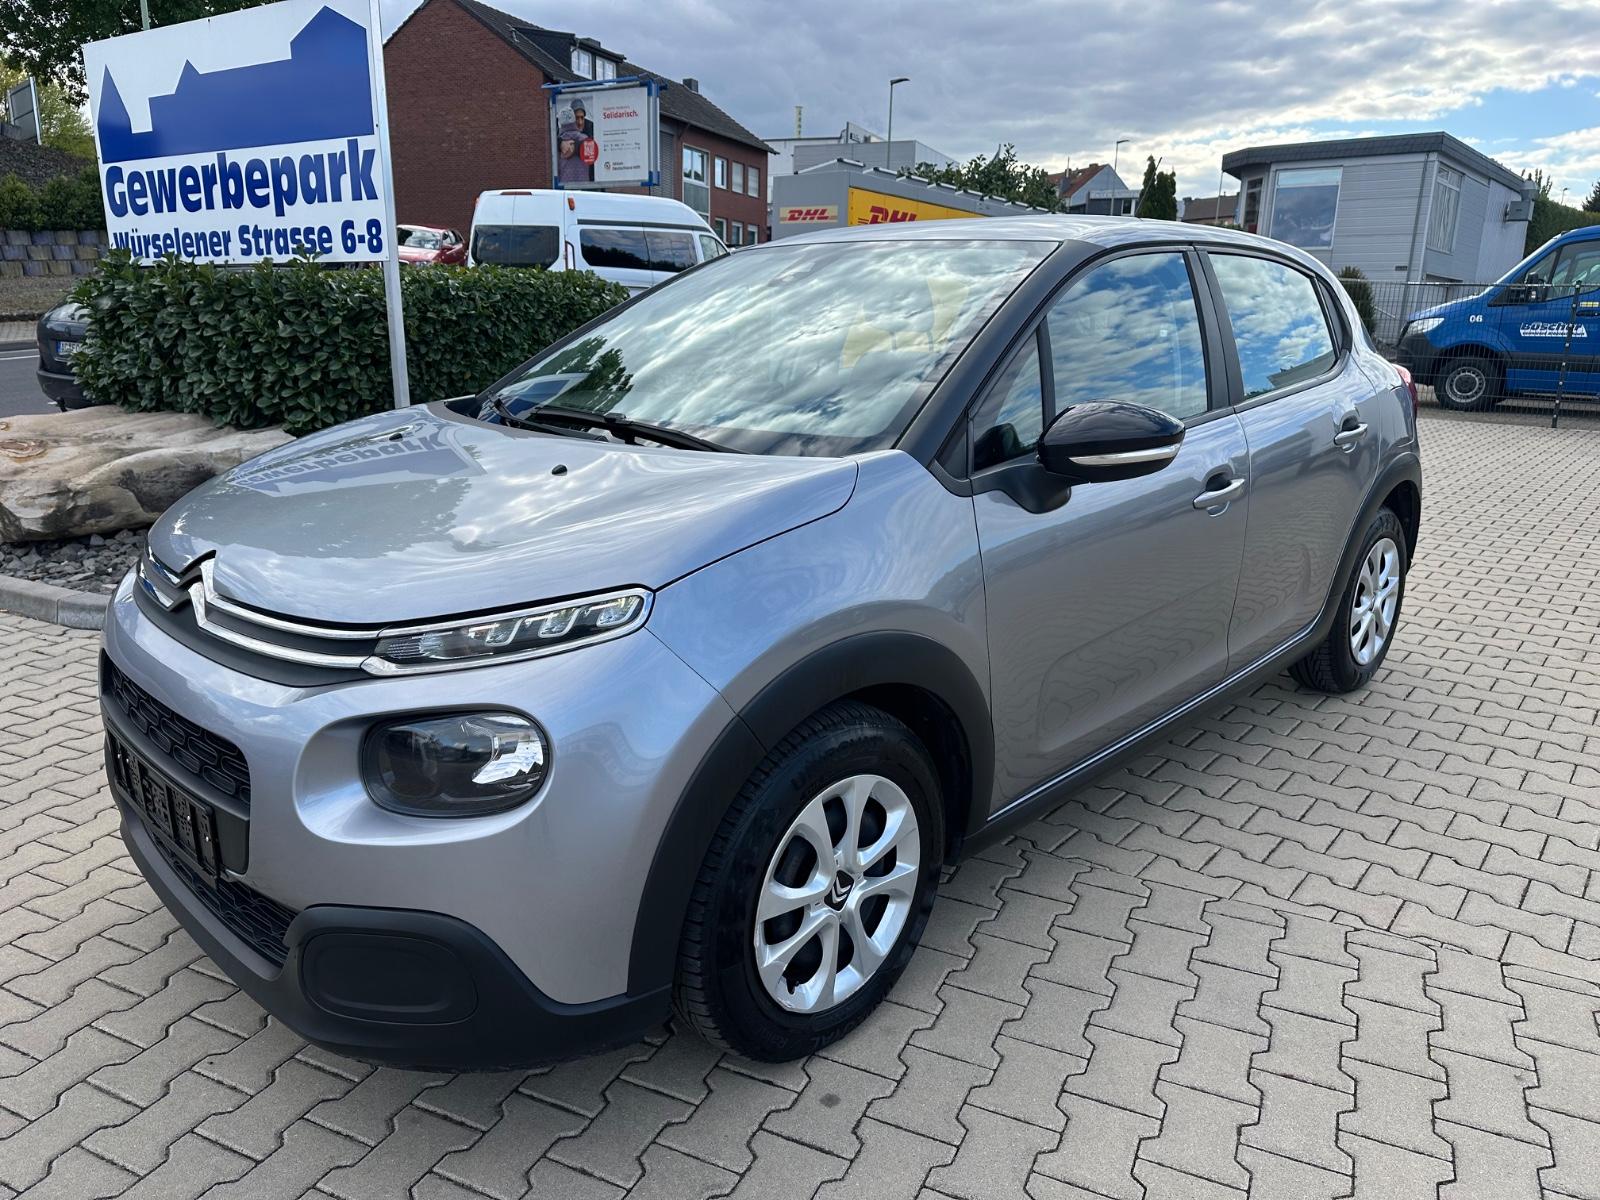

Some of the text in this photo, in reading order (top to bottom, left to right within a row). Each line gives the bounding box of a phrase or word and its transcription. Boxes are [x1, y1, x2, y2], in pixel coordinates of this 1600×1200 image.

[105, 138, 379, 218] Gewerbepark
[788, 208, 829, 222] DHL
[113, 218, 383, 259] Würselener Strasse 6-8
[1469, 314, 1483, 323] 06
